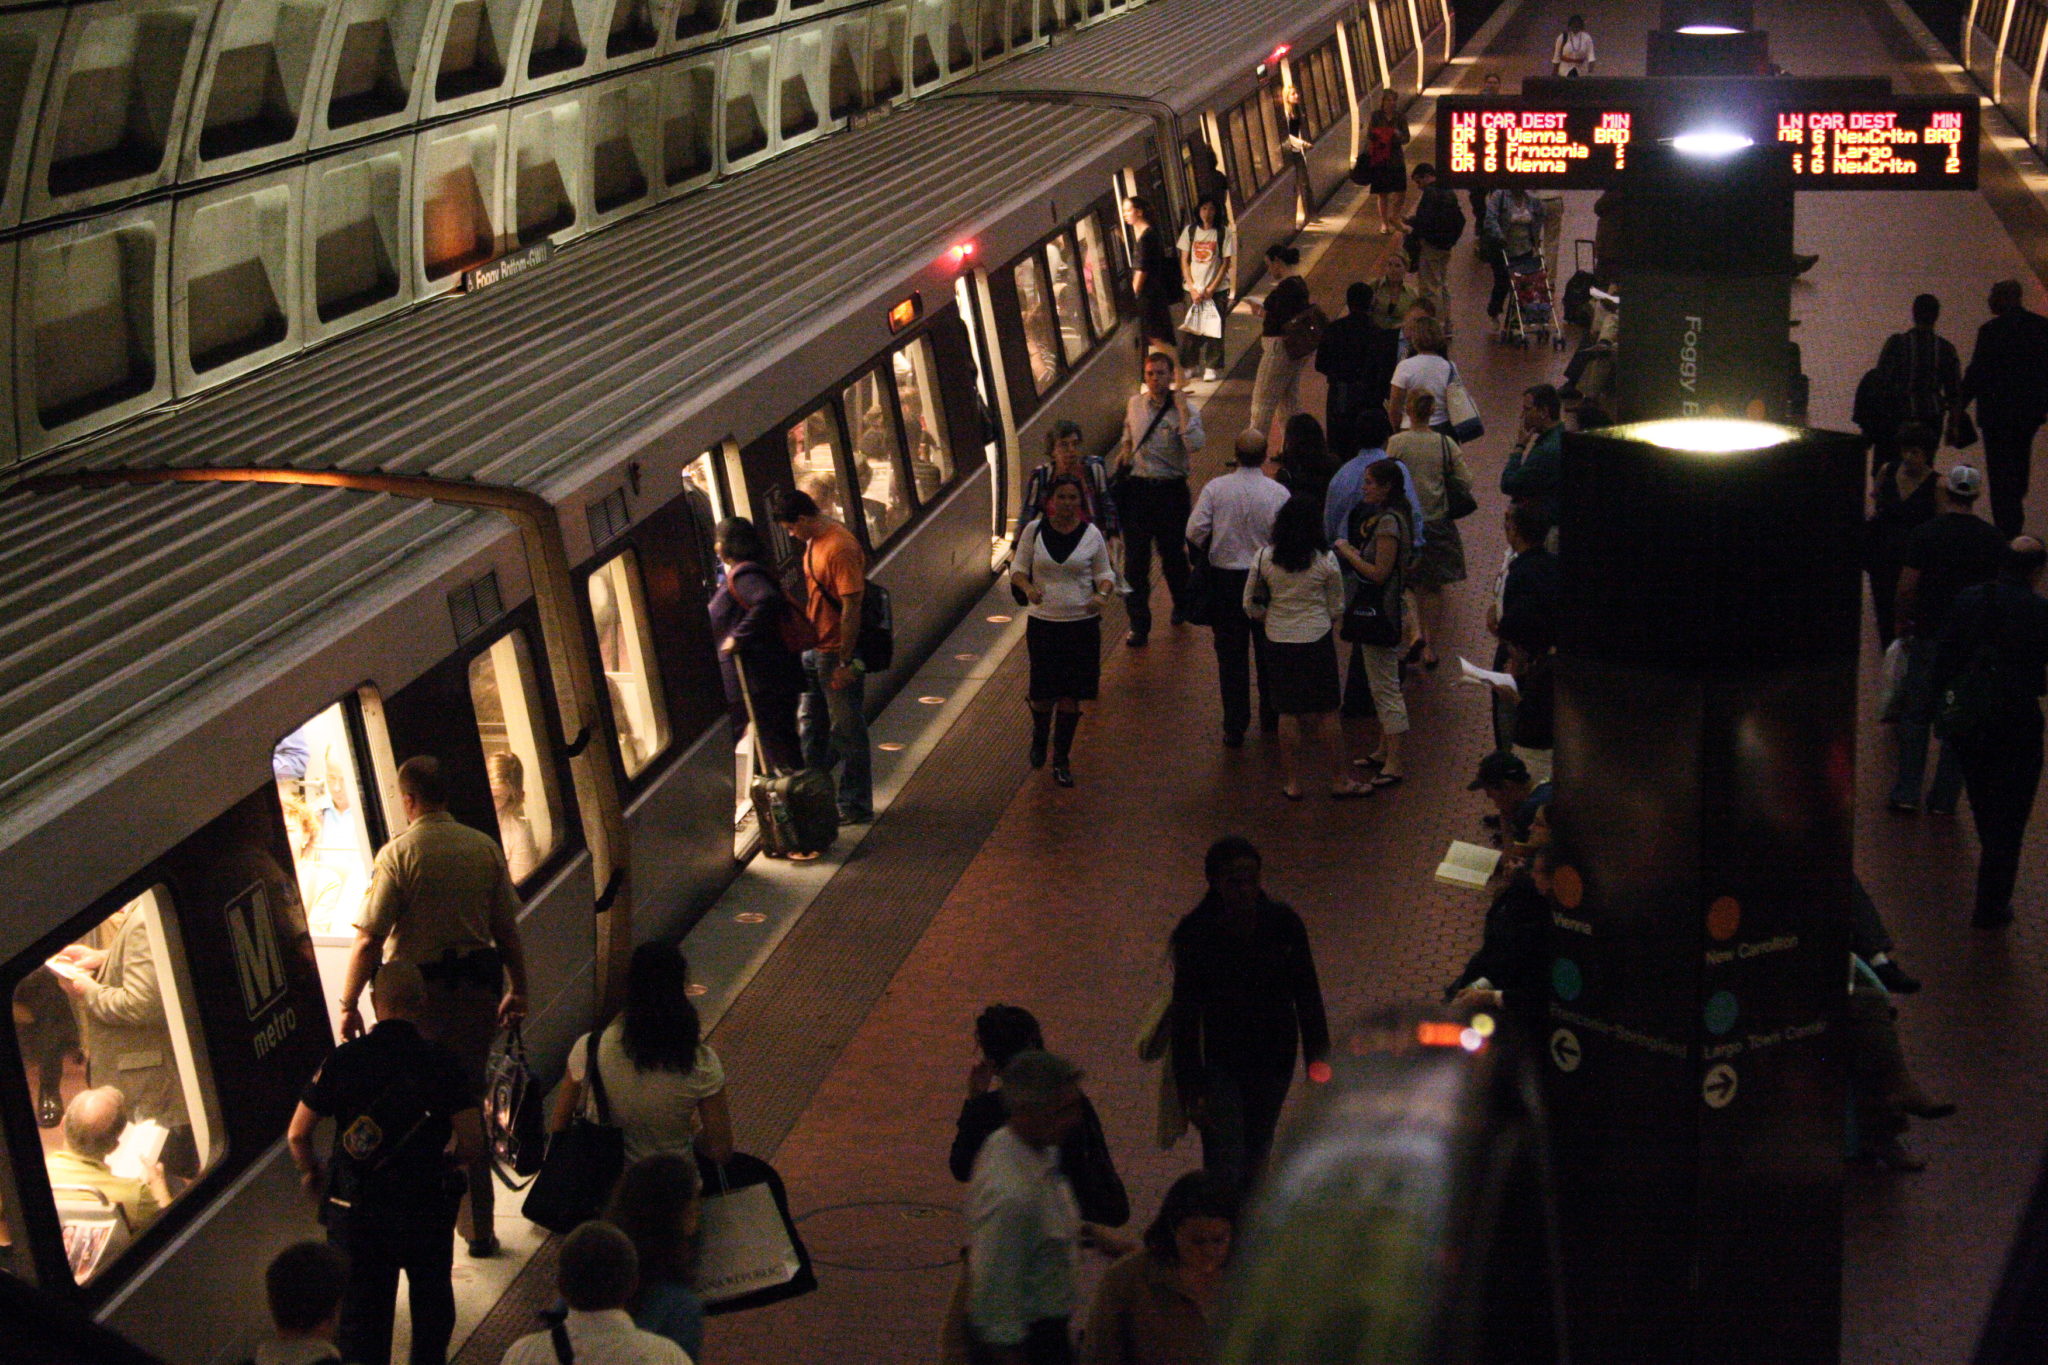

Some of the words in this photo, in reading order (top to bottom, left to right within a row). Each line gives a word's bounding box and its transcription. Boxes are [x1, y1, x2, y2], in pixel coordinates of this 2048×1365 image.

[1451, 112, 1476, 128] LN
[1481, 112, 1516, 128] CAR
[1522, 112, 1567, 128] DEST
[1602, 113, 1630, 129] MIN
[1778, 112, 1803, 129] LN
[1808, 112, 1845, 129] CAR
[1850, 112, 1897, 129] DEST
[1932, 112, 1962, 129] MIN
[1451, 127, 1476, 143] OR
[1484, 127, 1498, 143] 6
[1506, 127, 1567, 143] Vienna
[1594, 127, 1630, 144] BRD
[1811, 128, 1826, 144] 6
[1833, 128, 1918, 144] NewCrltn
[1924, 128, 1961, 144] BRD
[1451, 142, 1475, 158] BL
[1484, 142, 1497, 158] 4
[1505, 142, 1589, 159] Frnconia
[1810, 143, 1825, 159] 4
[1833, 143, 1893, 159] Largo
[1948, 143, 1958, 158] 1
[1451, 157, 1475, 172] OR
[1484, 157, 1497, 172] 6
[1505, 157, 1567, 172] Vienna
[1811, 158, 1824, 173] 6
[1832, 158, 1917, 173] NewCrltn
[1945, 157, 1960, 173] 2
[1680, 316, 1701, 392] Foggy
[253, 1006, 297, 1060] metro
